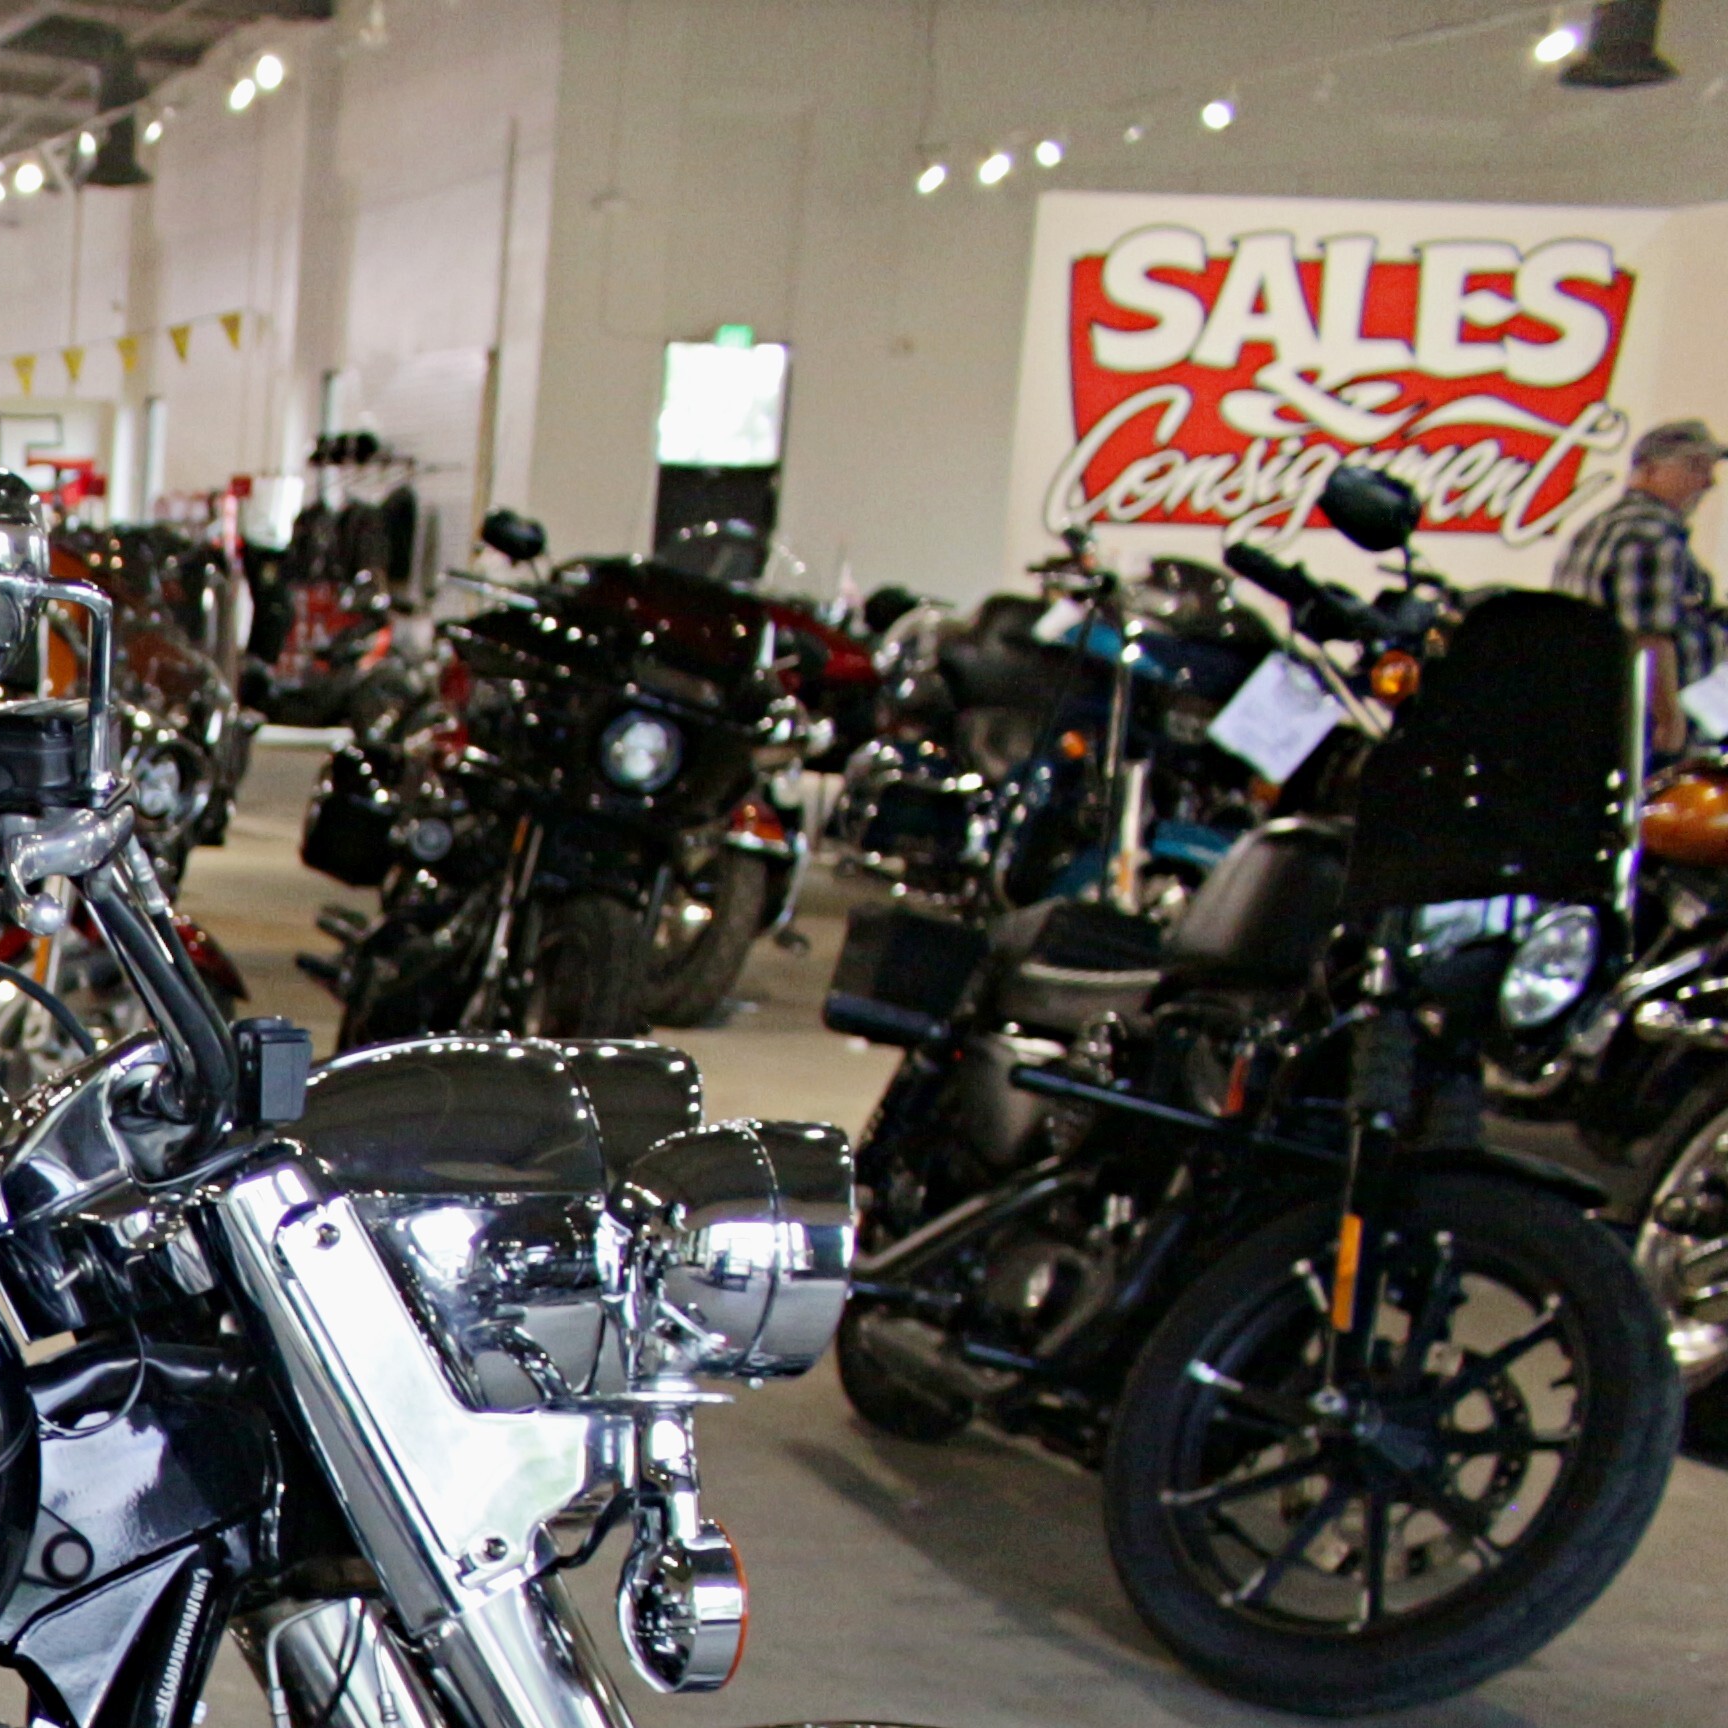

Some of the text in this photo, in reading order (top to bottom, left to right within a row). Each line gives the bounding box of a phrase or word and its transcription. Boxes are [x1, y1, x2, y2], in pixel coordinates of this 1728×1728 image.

[1089, 223, 1617, 388] SALES
[1046, 384, 1629, 548] Consigment
[1220, 364, 1426, 443] &
